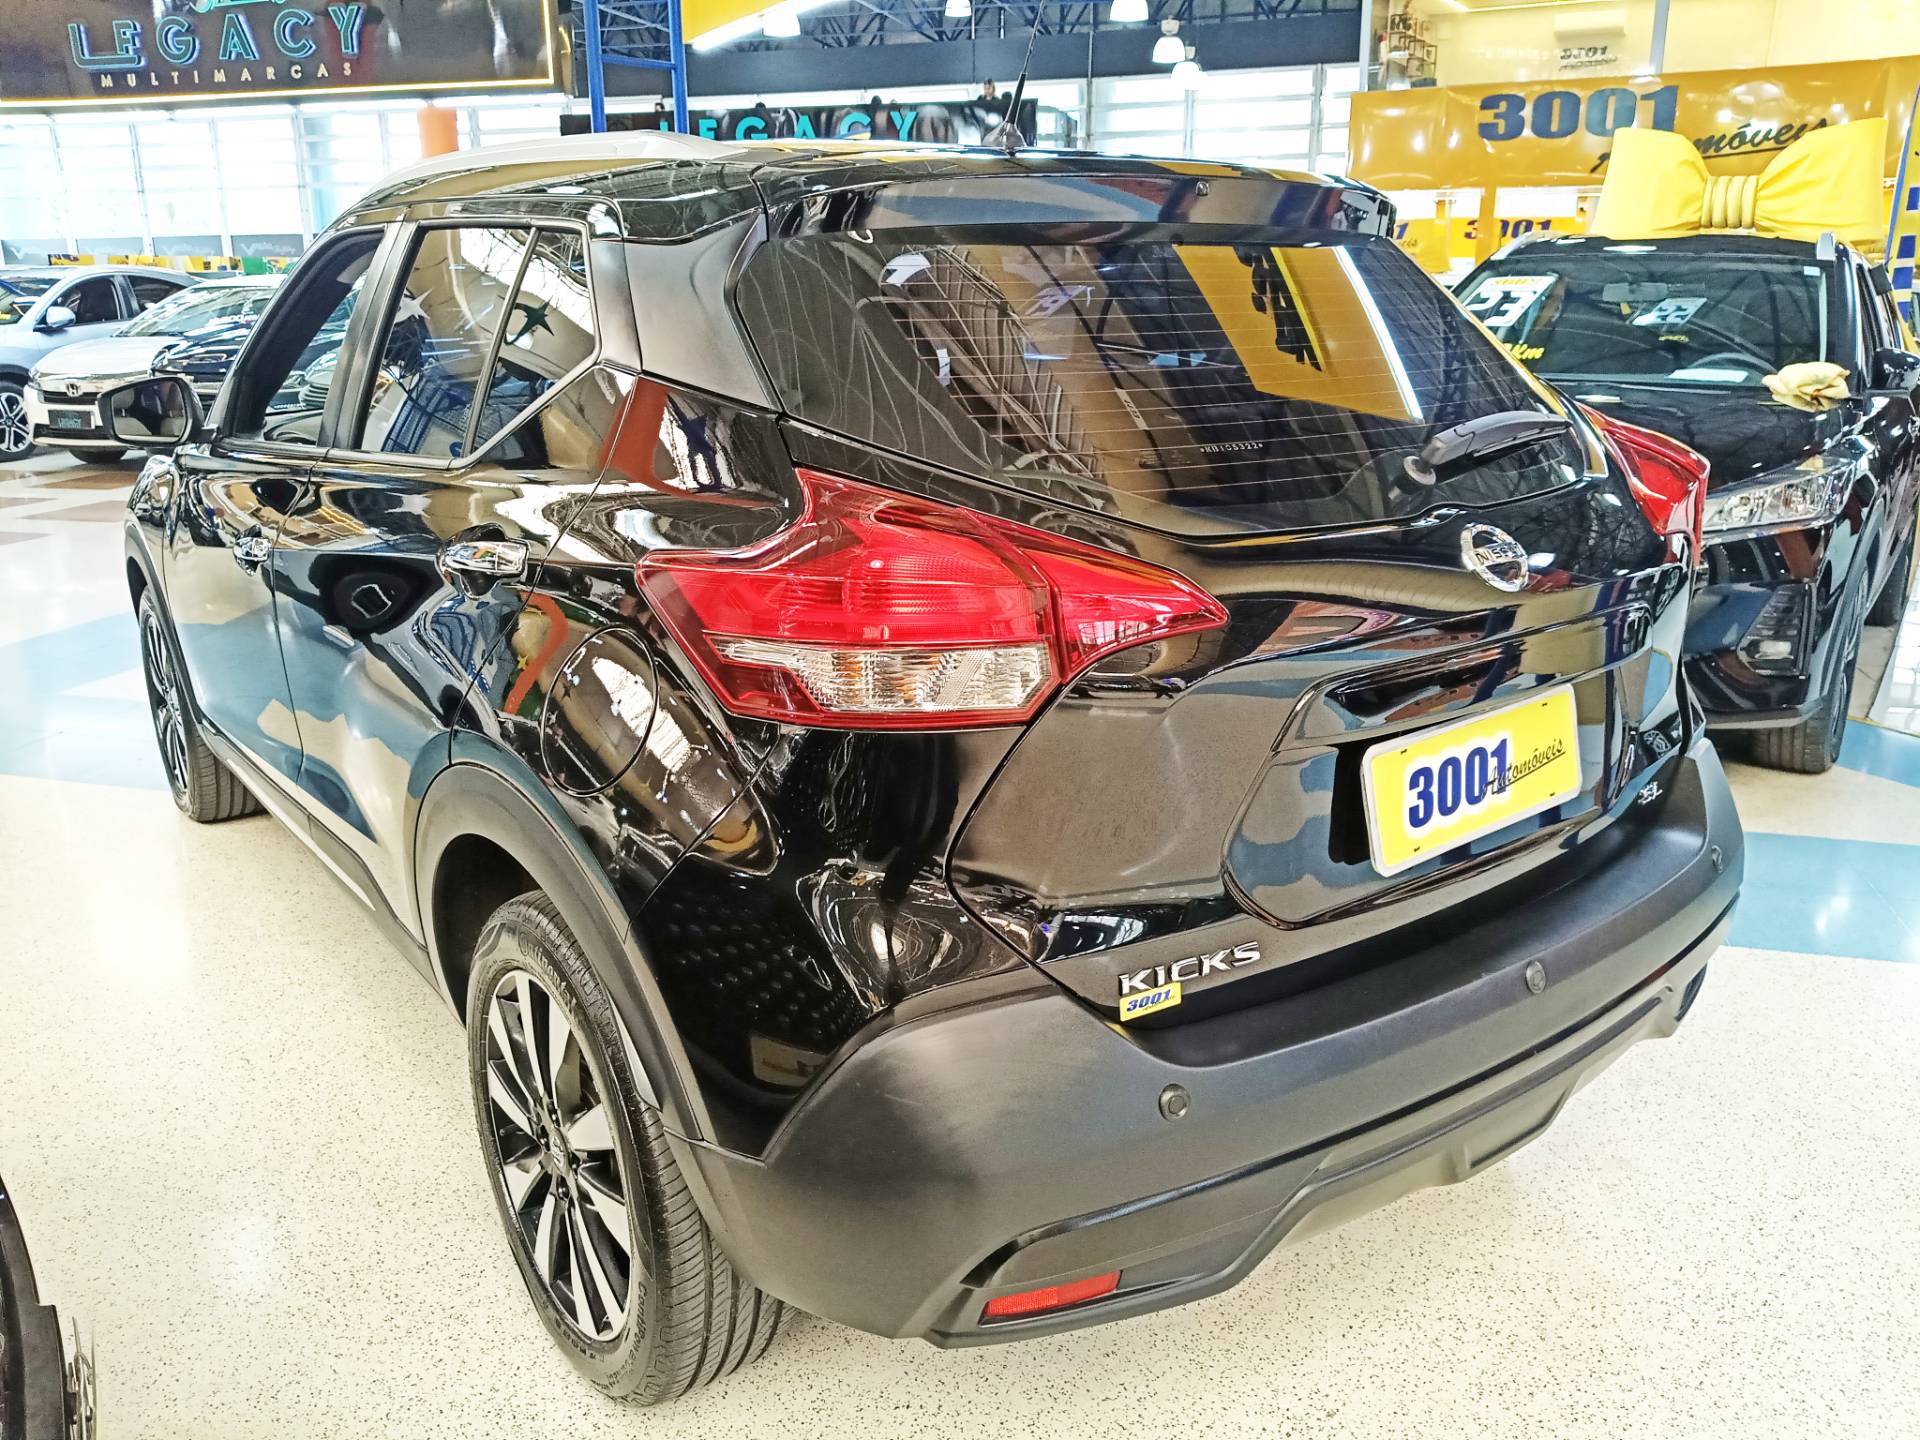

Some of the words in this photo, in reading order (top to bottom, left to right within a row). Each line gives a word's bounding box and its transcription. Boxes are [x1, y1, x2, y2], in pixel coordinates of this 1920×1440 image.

[67, 4, 367, 70] LEGACY
[100, 62, 353, 88] MULTIMARCAS
[1477, 85, 1680, 142] 3001
[1408, 737, 1508, 829] 3001
[1118, 940, 1261, 996] KICKS
[1126, 988, 1172, 1013] 3001
